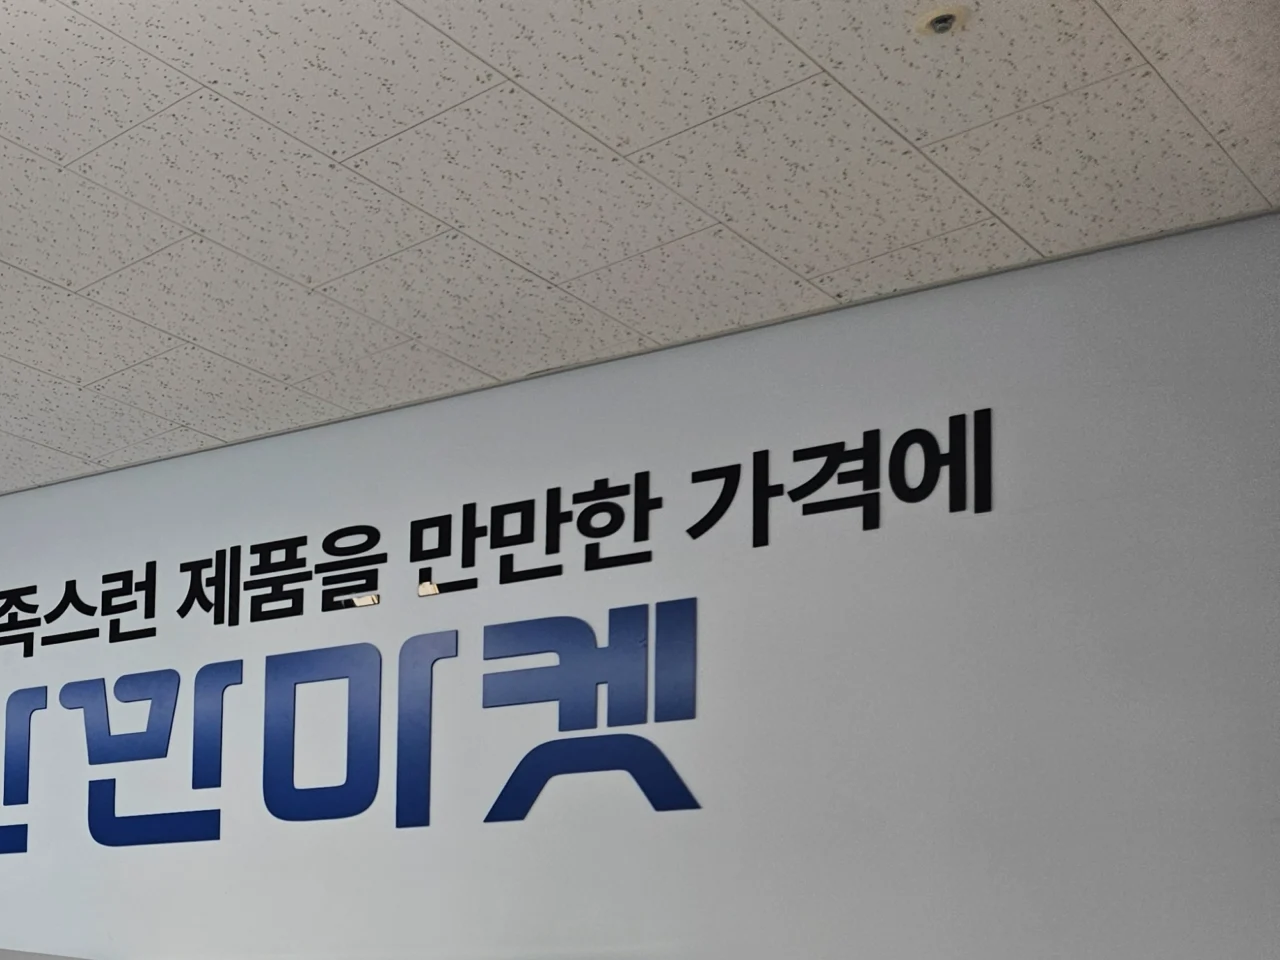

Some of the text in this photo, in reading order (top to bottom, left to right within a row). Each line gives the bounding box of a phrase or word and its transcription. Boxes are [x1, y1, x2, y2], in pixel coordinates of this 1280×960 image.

[176, 524, 388, 626] 제품을
[409, 471, 663, 597] 만만한
[685, 407, 993, 549] 가격에
